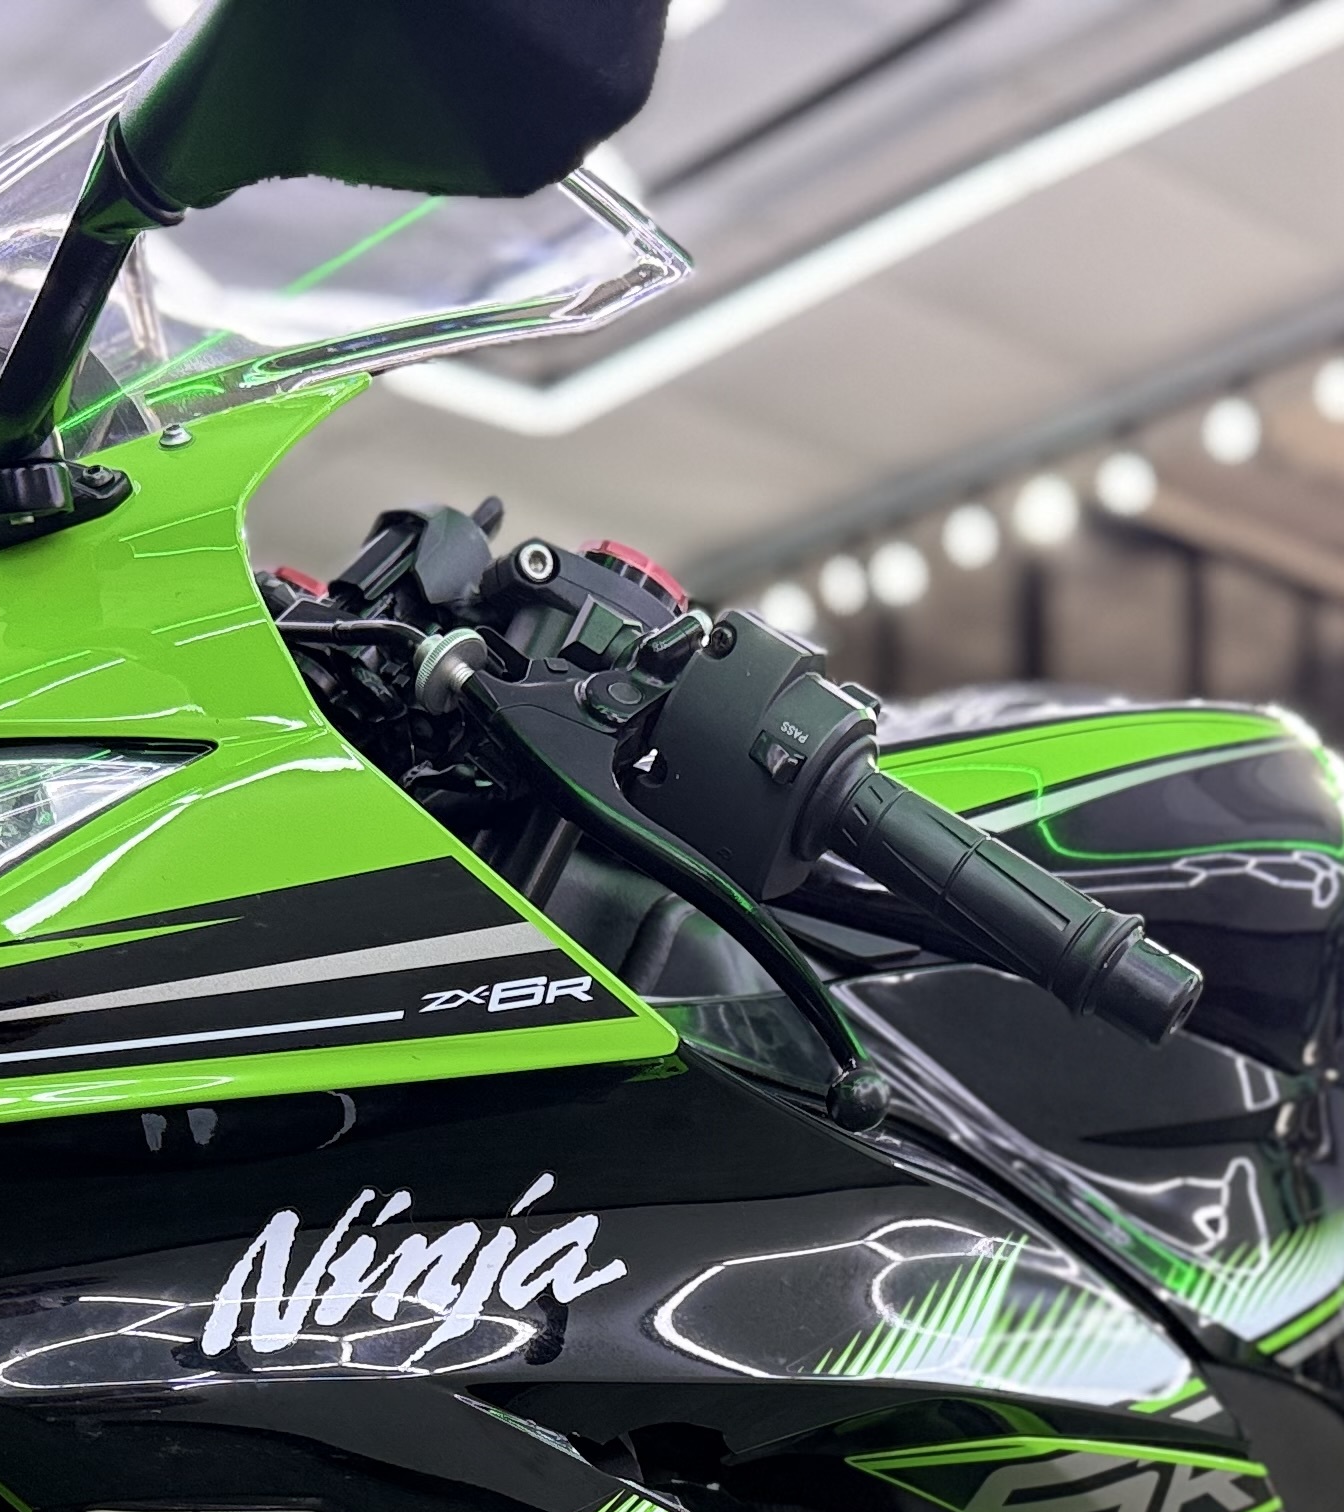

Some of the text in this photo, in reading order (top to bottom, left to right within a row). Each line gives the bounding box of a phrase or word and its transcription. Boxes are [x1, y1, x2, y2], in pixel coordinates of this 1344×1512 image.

[781, 721, 809, 744] PASS
[419, 975, 594, 1014] ZX-6R
[201, 1172, 627, 1370] Ninja
